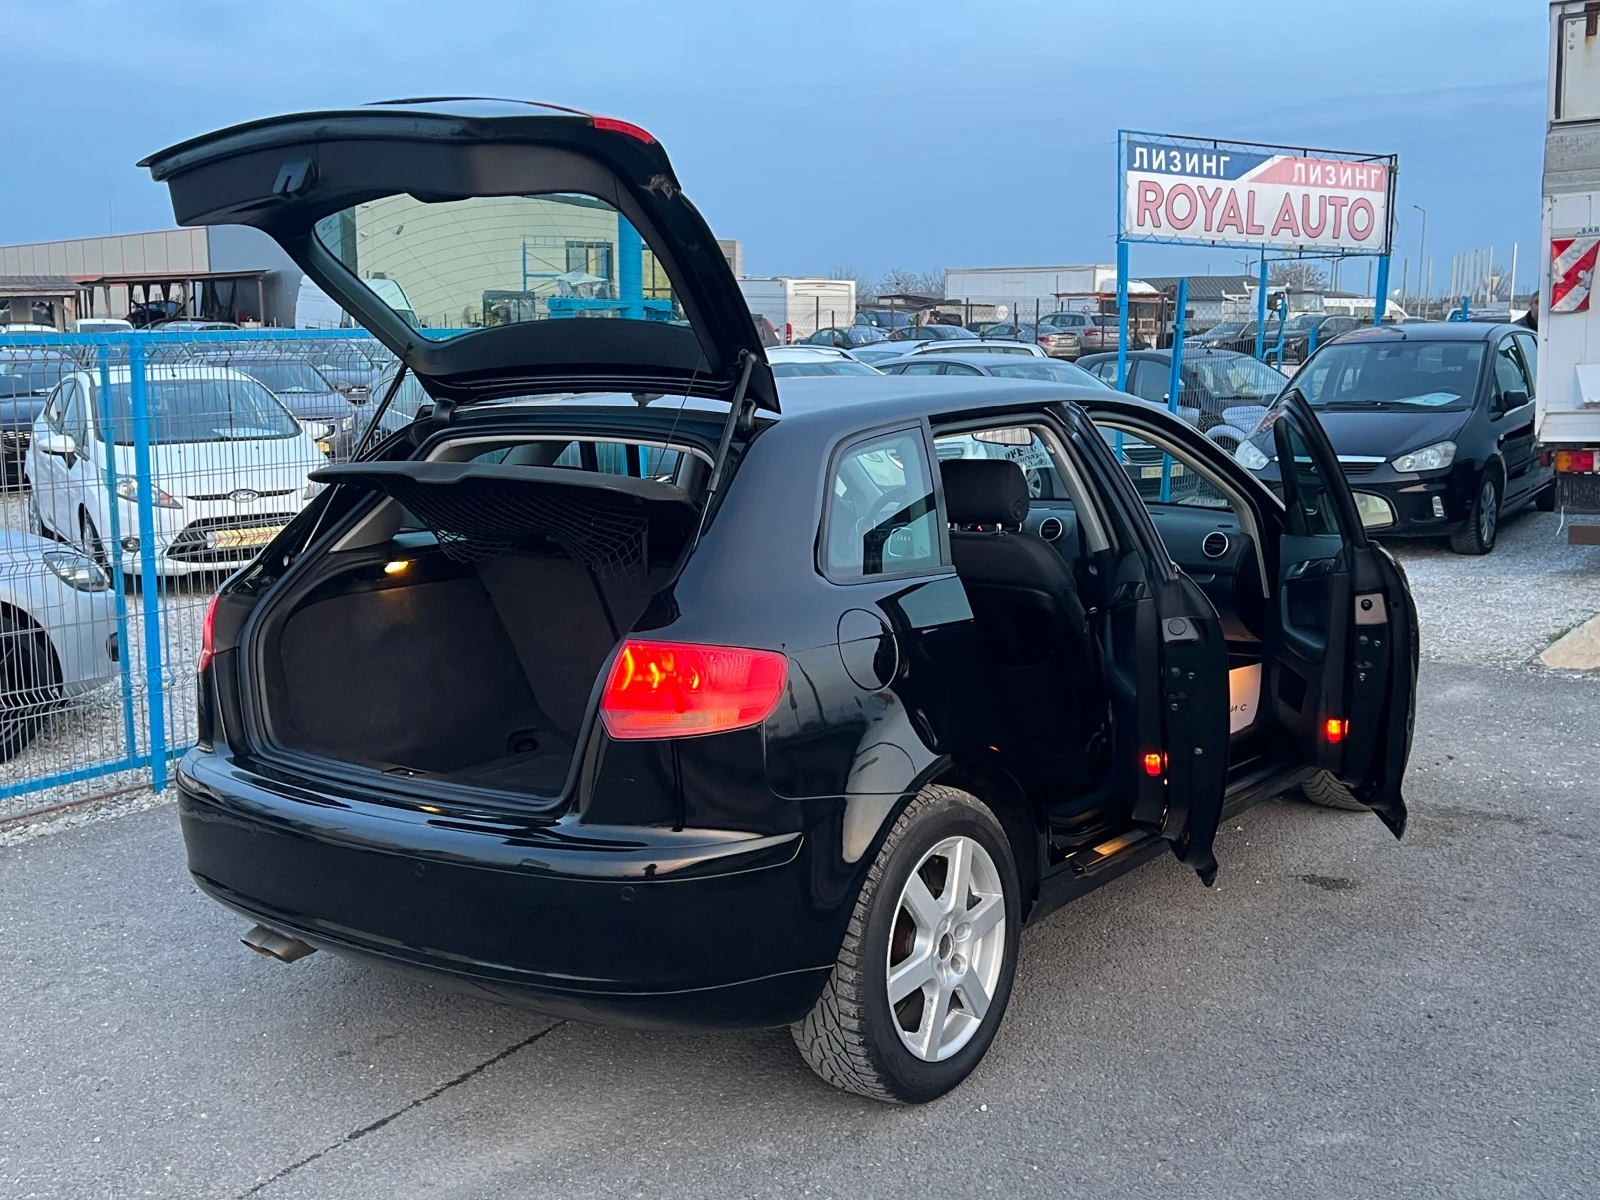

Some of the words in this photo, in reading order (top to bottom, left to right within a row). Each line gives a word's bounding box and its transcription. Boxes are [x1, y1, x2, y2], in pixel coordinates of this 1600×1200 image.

[1133, 147, 1231, 177] ЛИЗИНГ
[1292, 162, 1381, 189] ЛИЗИНГ
[1136, 180, 1265, 236] ROYAL
[1271, 192, 1376, 241] AUTO
